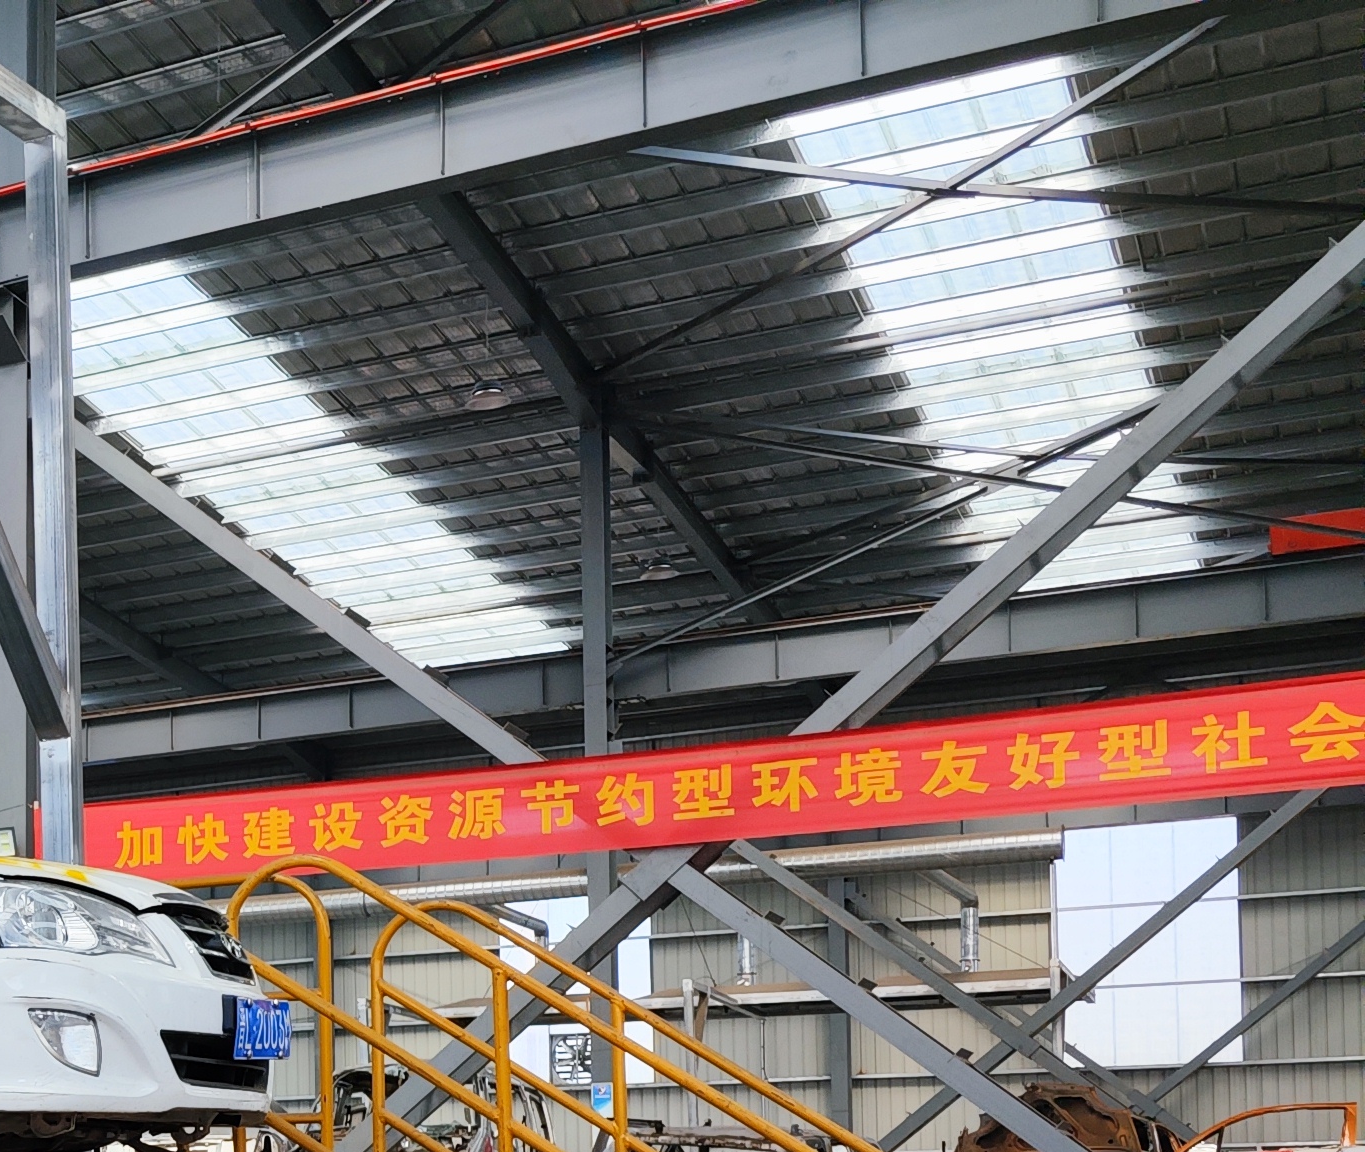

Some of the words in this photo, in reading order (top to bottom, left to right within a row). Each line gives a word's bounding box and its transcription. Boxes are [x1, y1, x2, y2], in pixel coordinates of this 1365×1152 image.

[114, 701, 1365, 869] 加快建设资源节约型环境友好型社会
